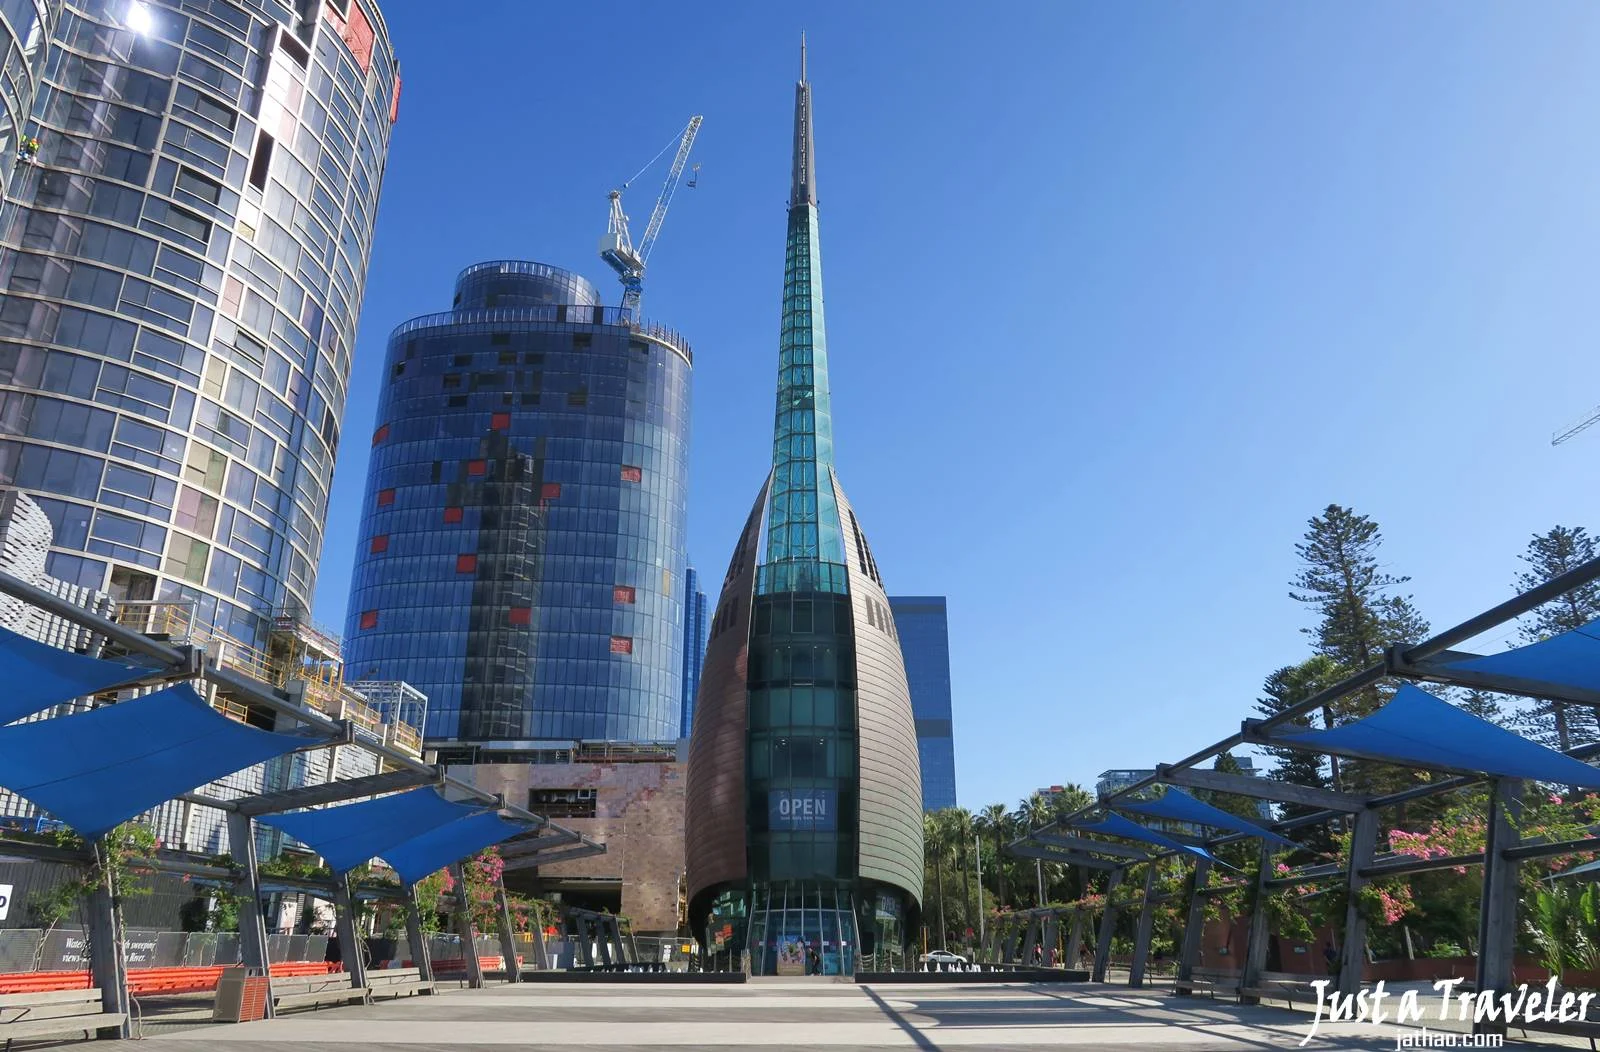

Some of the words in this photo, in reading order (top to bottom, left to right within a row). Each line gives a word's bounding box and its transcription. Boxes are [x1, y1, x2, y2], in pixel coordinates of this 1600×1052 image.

[780, 798, 826, 815] OPEN
[130, 940, 157, 952] sweeping
[62, 951, 80, 962] views
